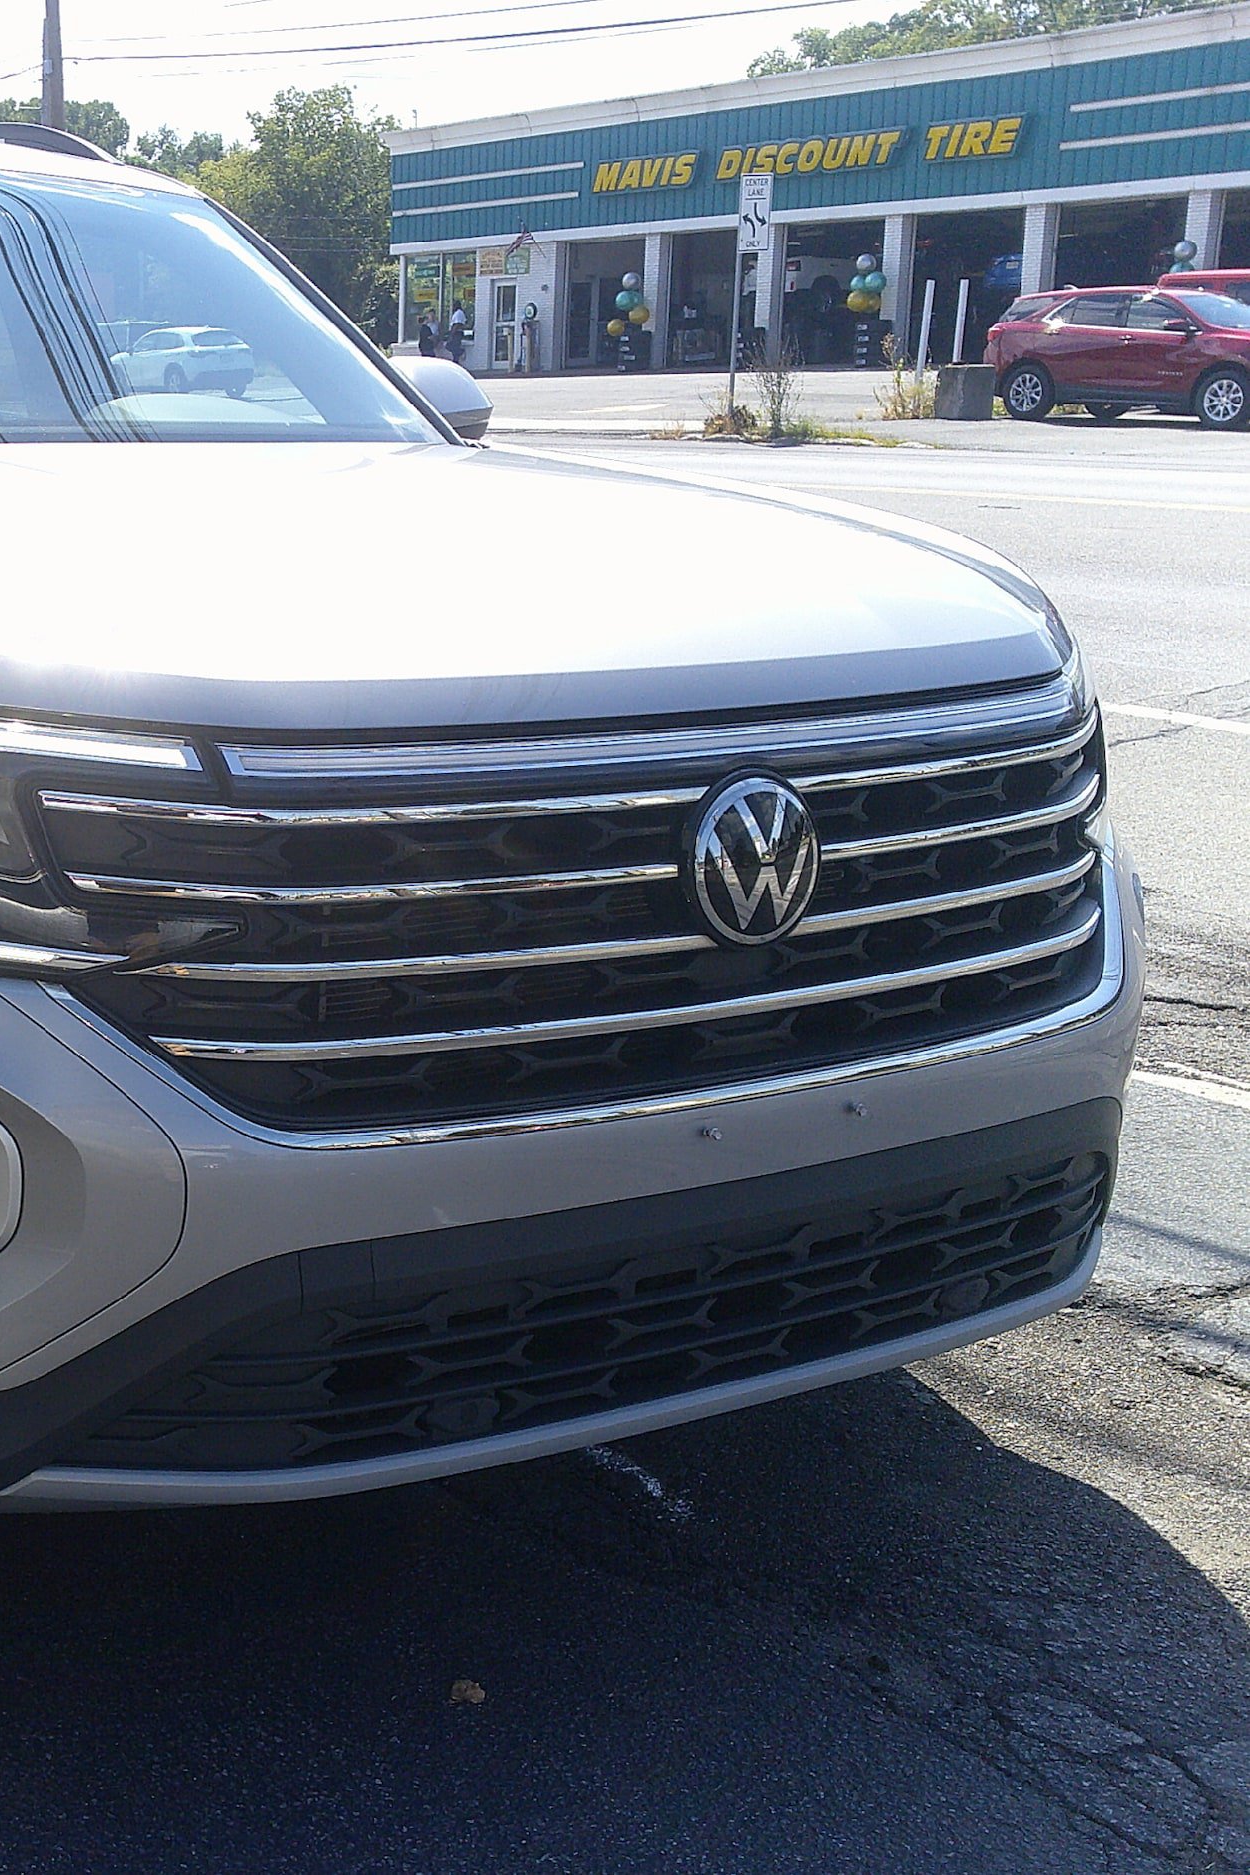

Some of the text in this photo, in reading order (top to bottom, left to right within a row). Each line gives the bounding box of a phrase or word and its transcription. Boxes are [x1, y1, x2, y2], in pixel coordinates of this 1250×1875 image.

[592, 117, 1022, 193] MAVIS DISCOUNT TIRE
[745, 178, 769, 187] CENTER
[748, 188, 765, 196] LANE
[746, 240, 760, 248] ONLY
